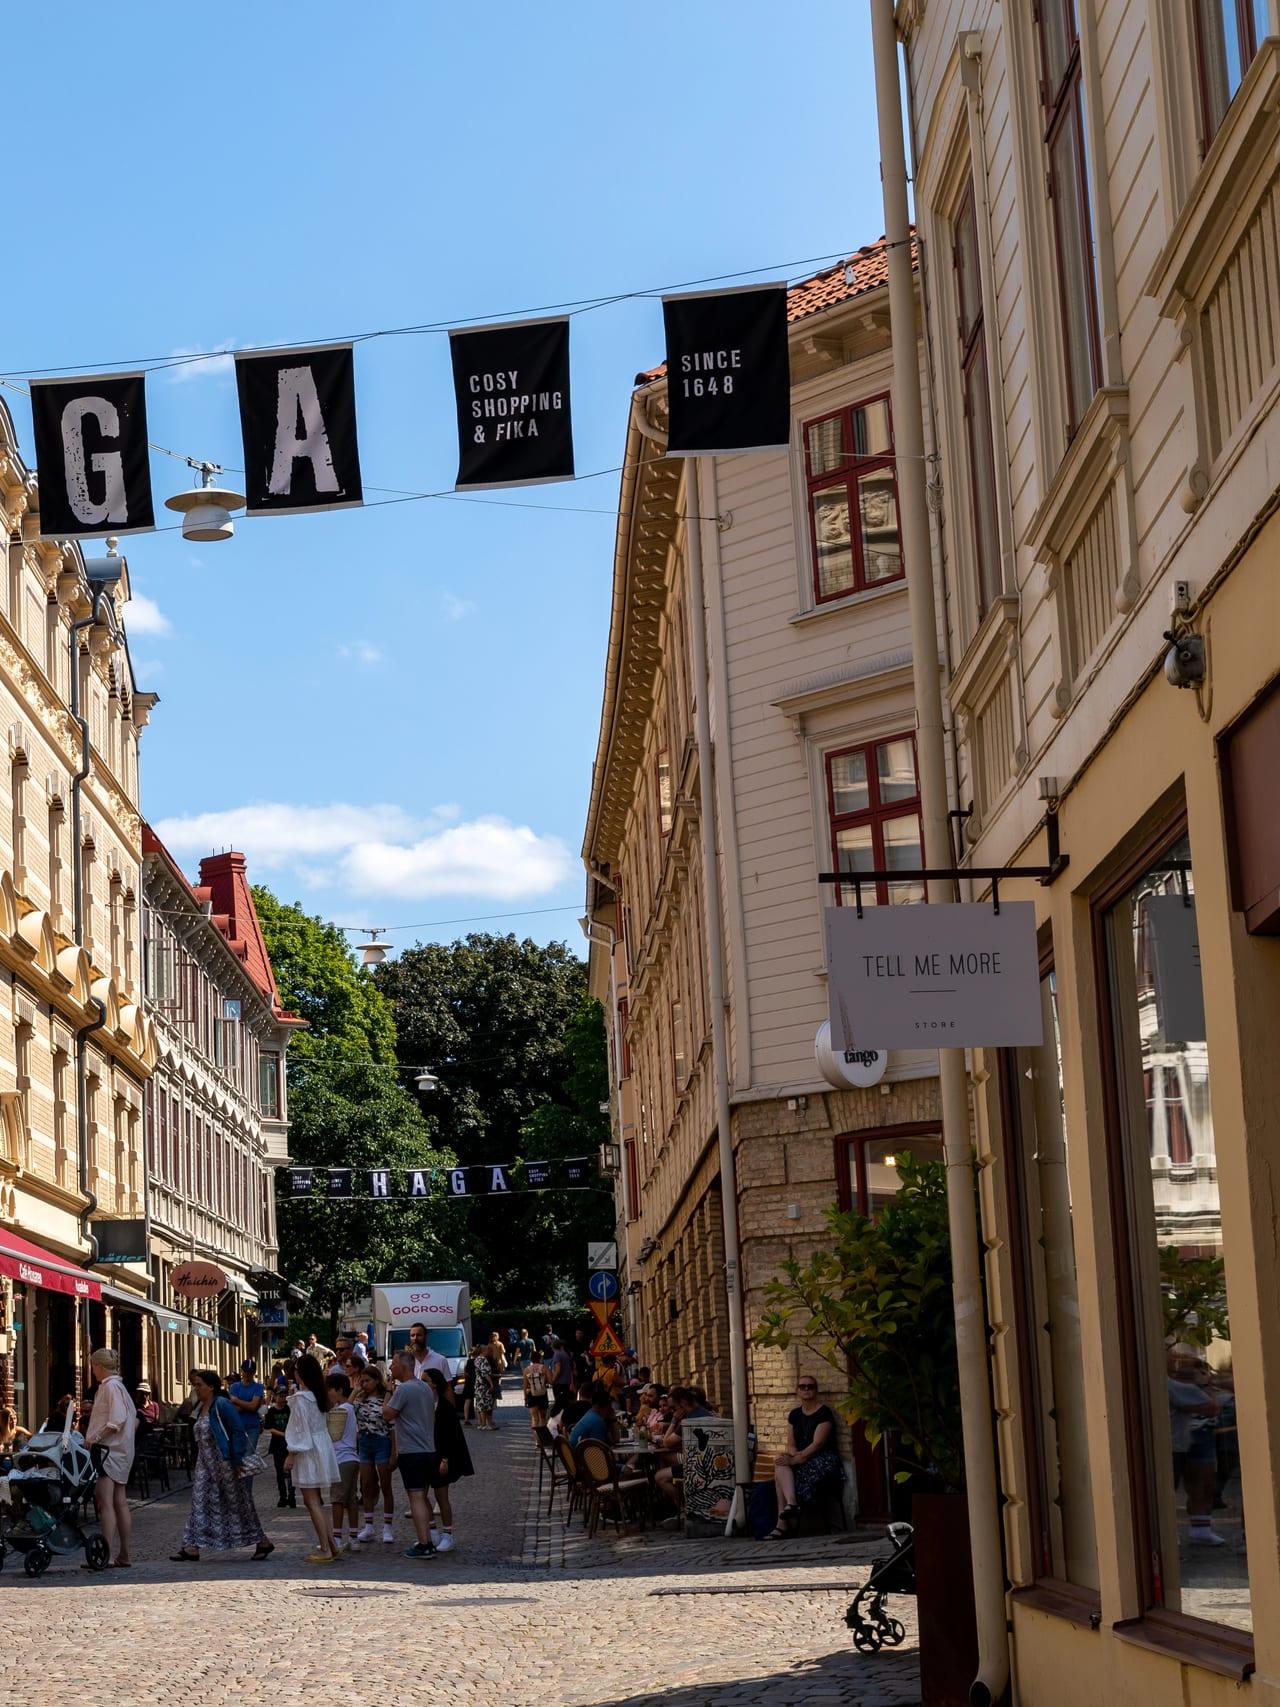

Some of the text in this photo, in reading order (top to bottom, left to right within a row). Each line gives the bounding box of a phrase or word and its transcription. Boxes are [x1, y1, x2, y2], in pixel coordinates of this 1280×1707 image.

[681, 349, 742, 373] SINCE
[469, 370, 518, 393] COSY
[683, 375, 733, 398] 1648
[471, 391, 562, 418] SHOPPING
[473, 418, 539, 443] & FIKA
[862, 952, 1002, 977] TELL ME MORE
[914, 1021, 956, 1029] STORE
[372, 1167, 508, 1197] HAGA
[410, 1293, 431, 1303] go
[392, 1305, 454, 1316] GOGROSS
